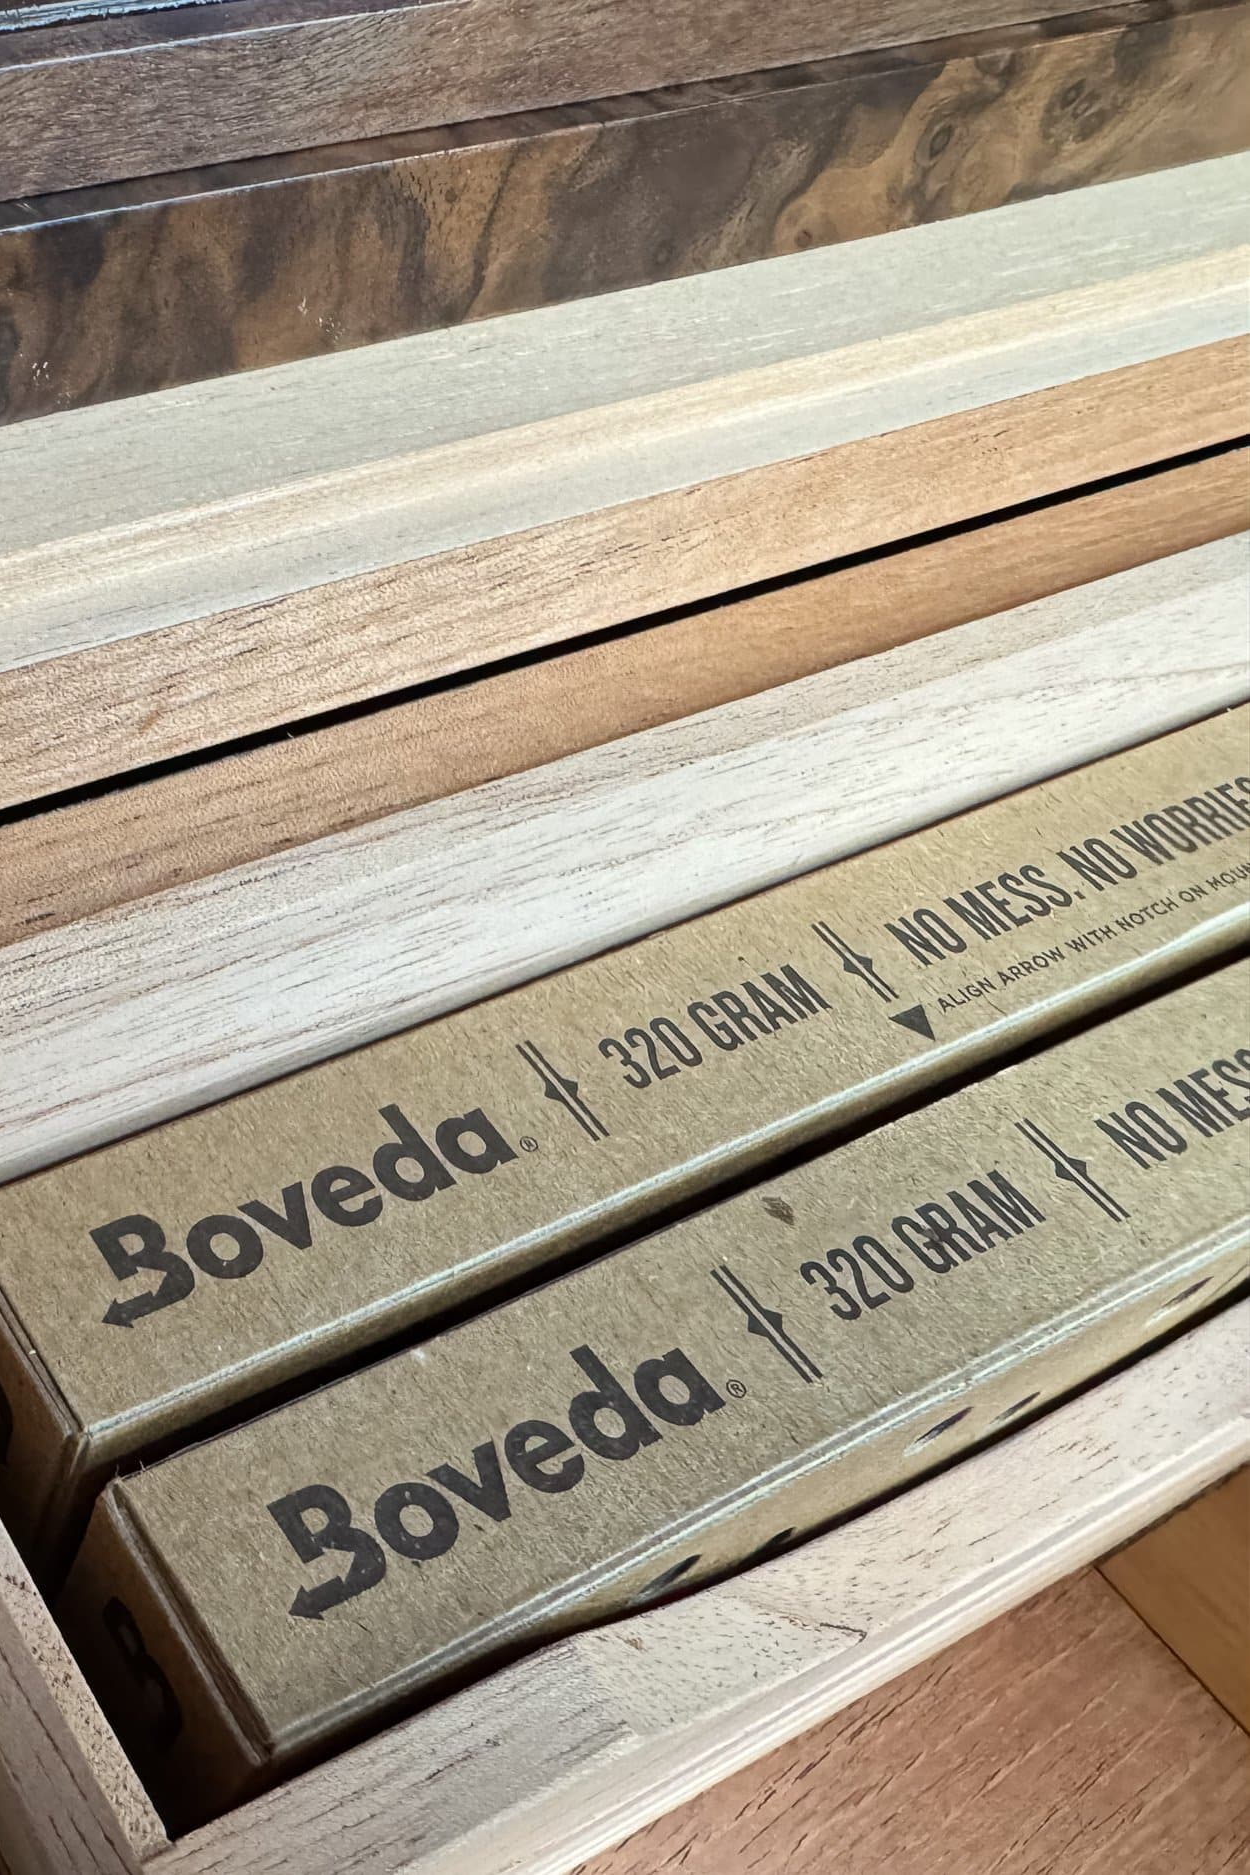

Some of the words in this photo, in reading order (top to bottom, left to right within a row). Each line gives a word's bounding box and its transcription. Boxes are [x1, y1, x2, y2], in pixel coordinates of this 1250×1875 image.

[884, 908, 967, 966] NO
[943, 865, 1086, 940] MESS.
[1056, 838, 1138, 891] NO
[937, 977, 997, 1013] ALIGN
[997, 946, 1065, 986] ARROW
[1064, 925, 1118, 952] WITH
[1115, 897, 1180, 932] NOTCH
[1178, 885, 1209, 902] ON
[598, 1017, 703, 1089] 320
[687, 964, 833, 1051] GRAM
[1094, 1102, 1187, 1170] NO
[800, 1236, 914, 1320] 320
[891, 1170, 1046, 1273] GRAM
